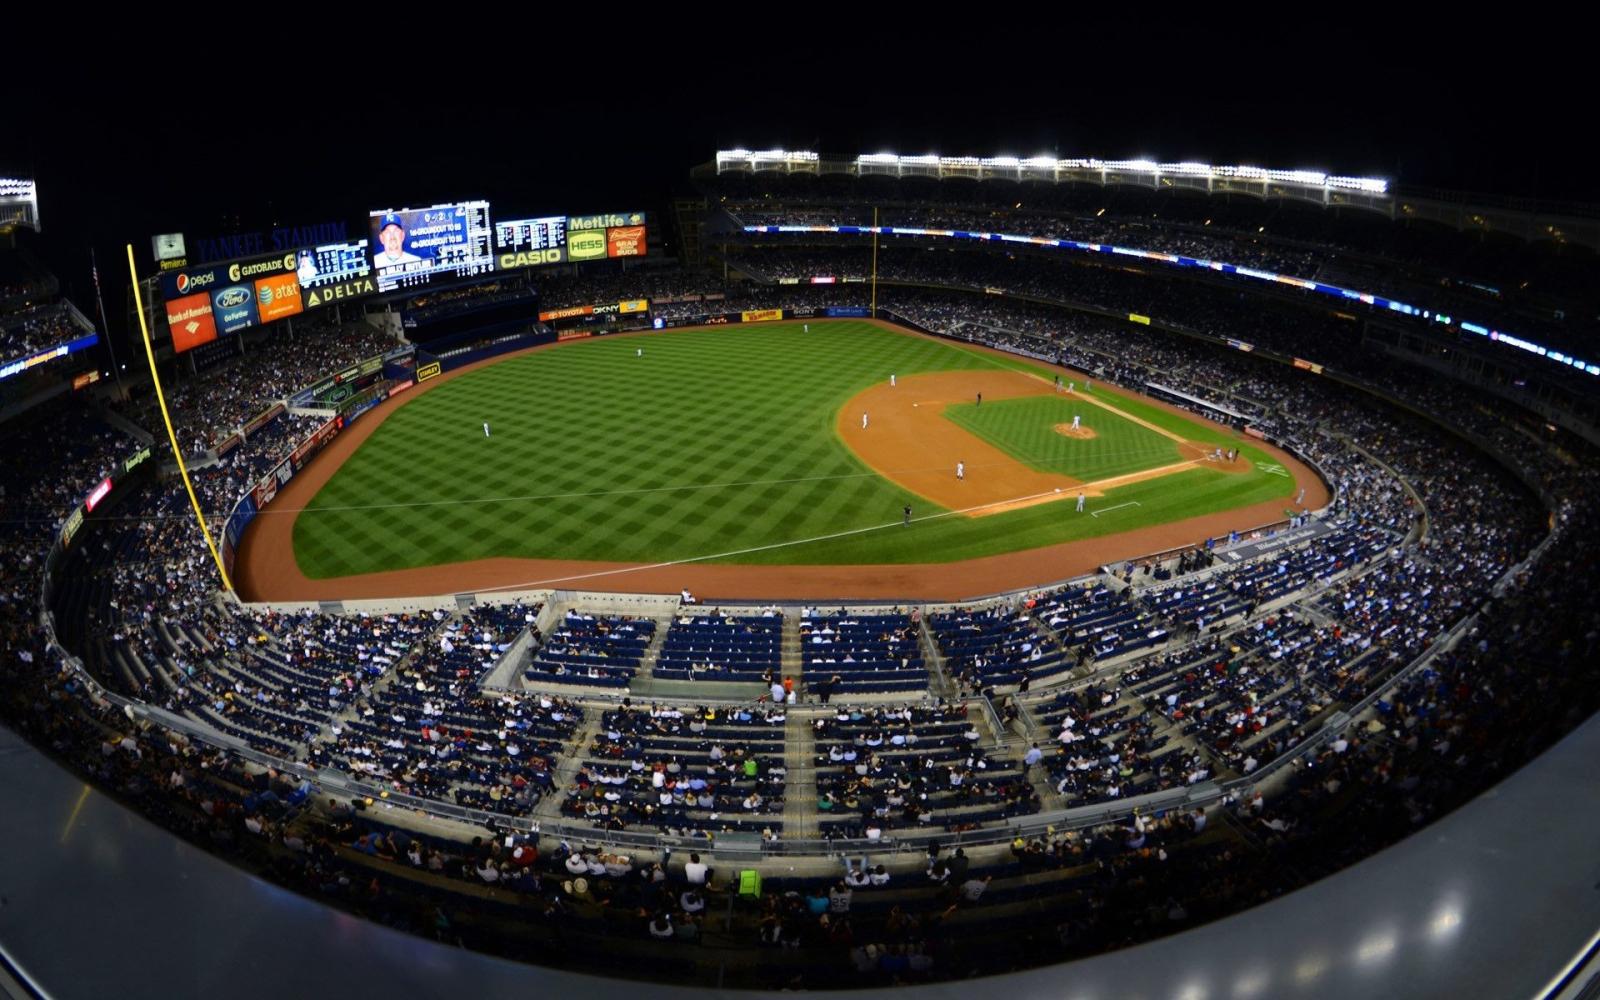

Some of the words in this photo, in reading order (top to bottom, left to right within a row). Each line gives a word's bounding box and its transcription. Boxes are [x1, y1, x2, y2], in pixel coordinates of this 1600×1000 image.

[570, 214, 624, 231] MetLife
[198, 232, 264, 262] YANKEE
[271, 223, 348, 250] STADIUM
[571, 239, 604, 251] HESS
[241, 259, 283, 276] GATORADE
[500, 249, 561, 269] CASIO
[190, 271, 215, 288] pepsi
[222, 290, 243, 307] Ford
[275, 283, 299, 300] at&t
[323, 280, 373, 302] DELTA
[168, 312, 183, 325] Bank
[182, 309, 189, 319] of
[189, 305, 212, 318] America
[558, 308, 584, 318] TOYOTA
[592, 304, 620, 314] DKNY
[224, 314, 231, 322] Go
[419, 365, 439, 379] STANLEY
[831, 897, 848, 907] 25
